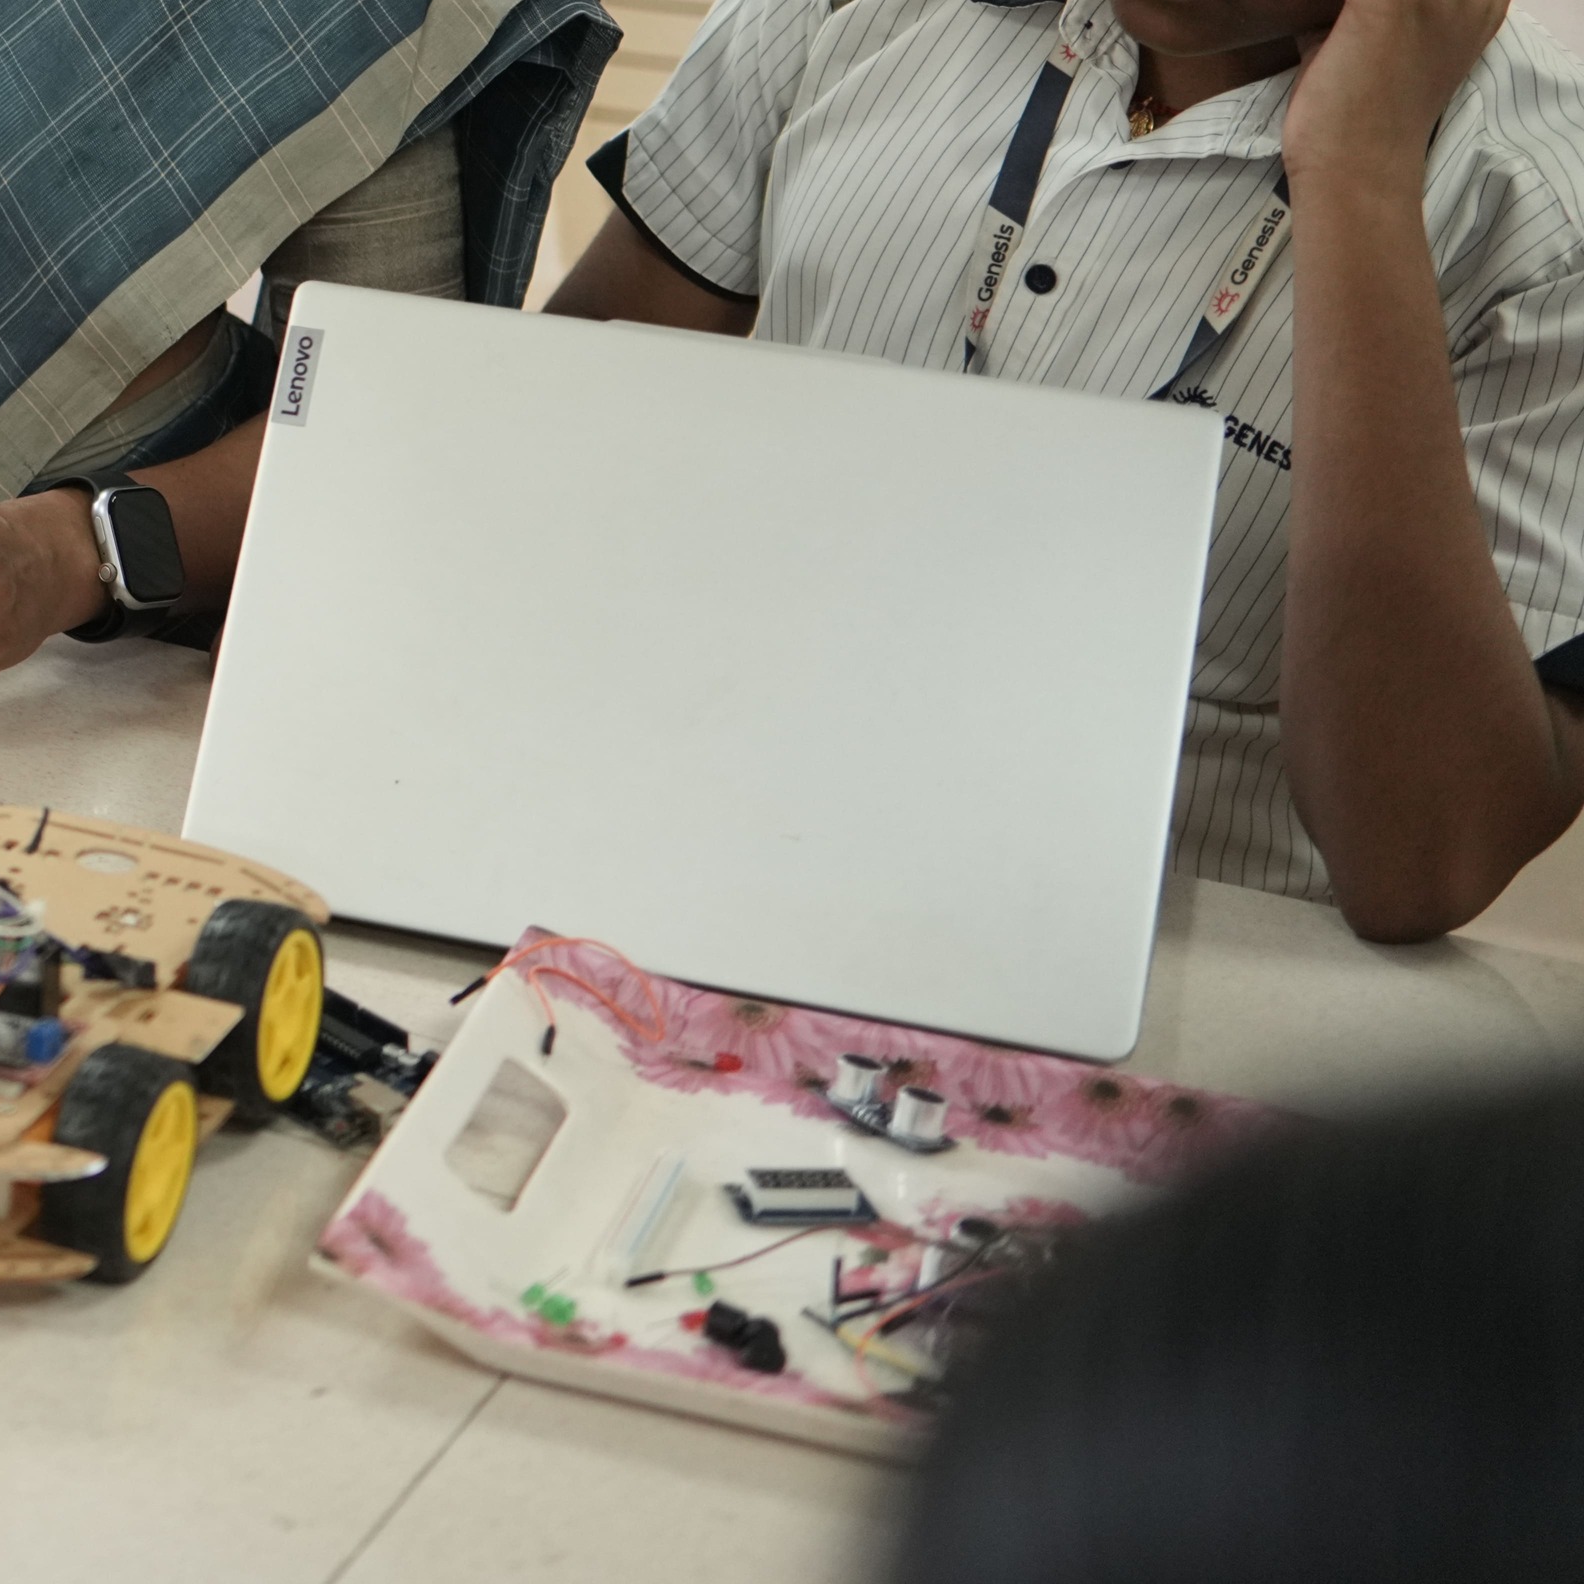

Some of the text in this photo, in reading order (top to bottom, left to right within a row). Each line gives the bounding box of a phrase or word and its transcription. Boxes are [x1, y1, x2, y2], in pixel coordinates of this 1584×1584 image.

[977, 224, 1014, 302] Genesis
[1231, 208, 1286, 285] Genesis
[281, 336, 313, 416] Lenovo
